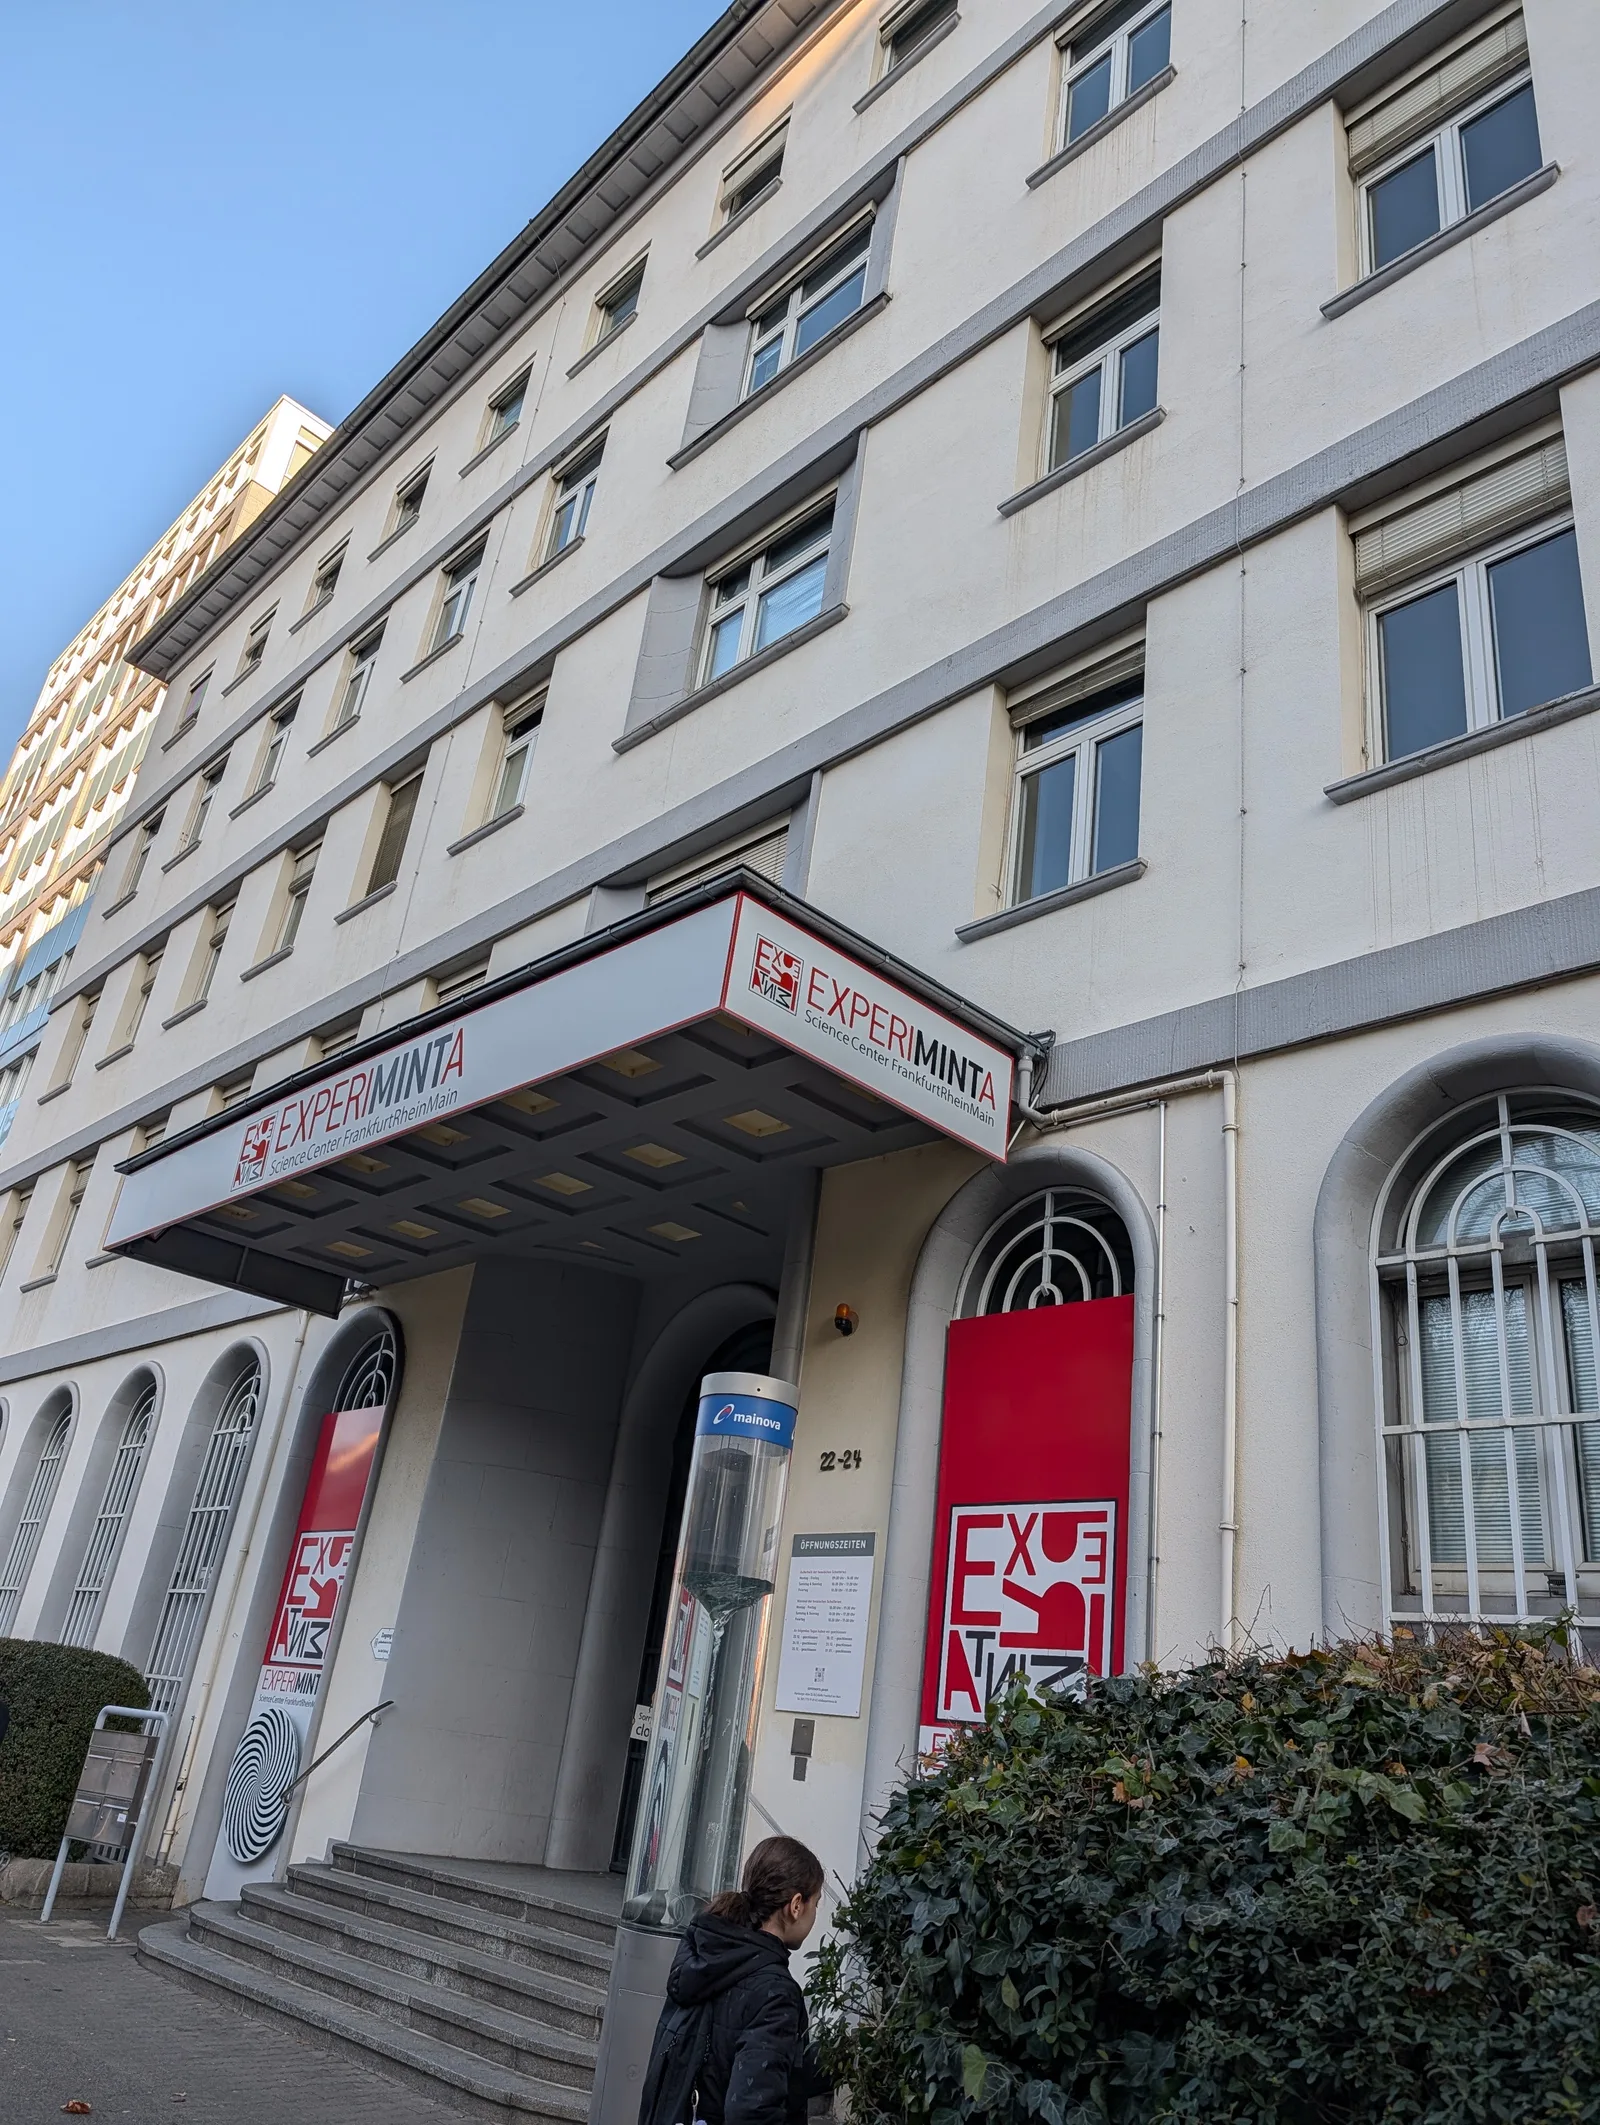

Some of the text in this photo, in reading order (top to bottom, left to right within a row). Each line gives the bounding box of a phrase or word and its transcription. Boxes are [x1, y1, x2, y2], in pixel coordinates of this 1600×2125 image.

[807, 966, 997, 1111] EXPERIMINTA
[273, 1027, 465, 1153] EXPERIMINTA
[342, 1087, 459, 1146] FrankfurtRheinMain
[891, 1057, 995, 1127] FrankfurtRheinMain
[733, 1412, 781, 1431] mainova
[820, 1449, 862, 1472] 22-24
[800, 1539, 867, 1550] ÖFFNUNGSZEITEN
